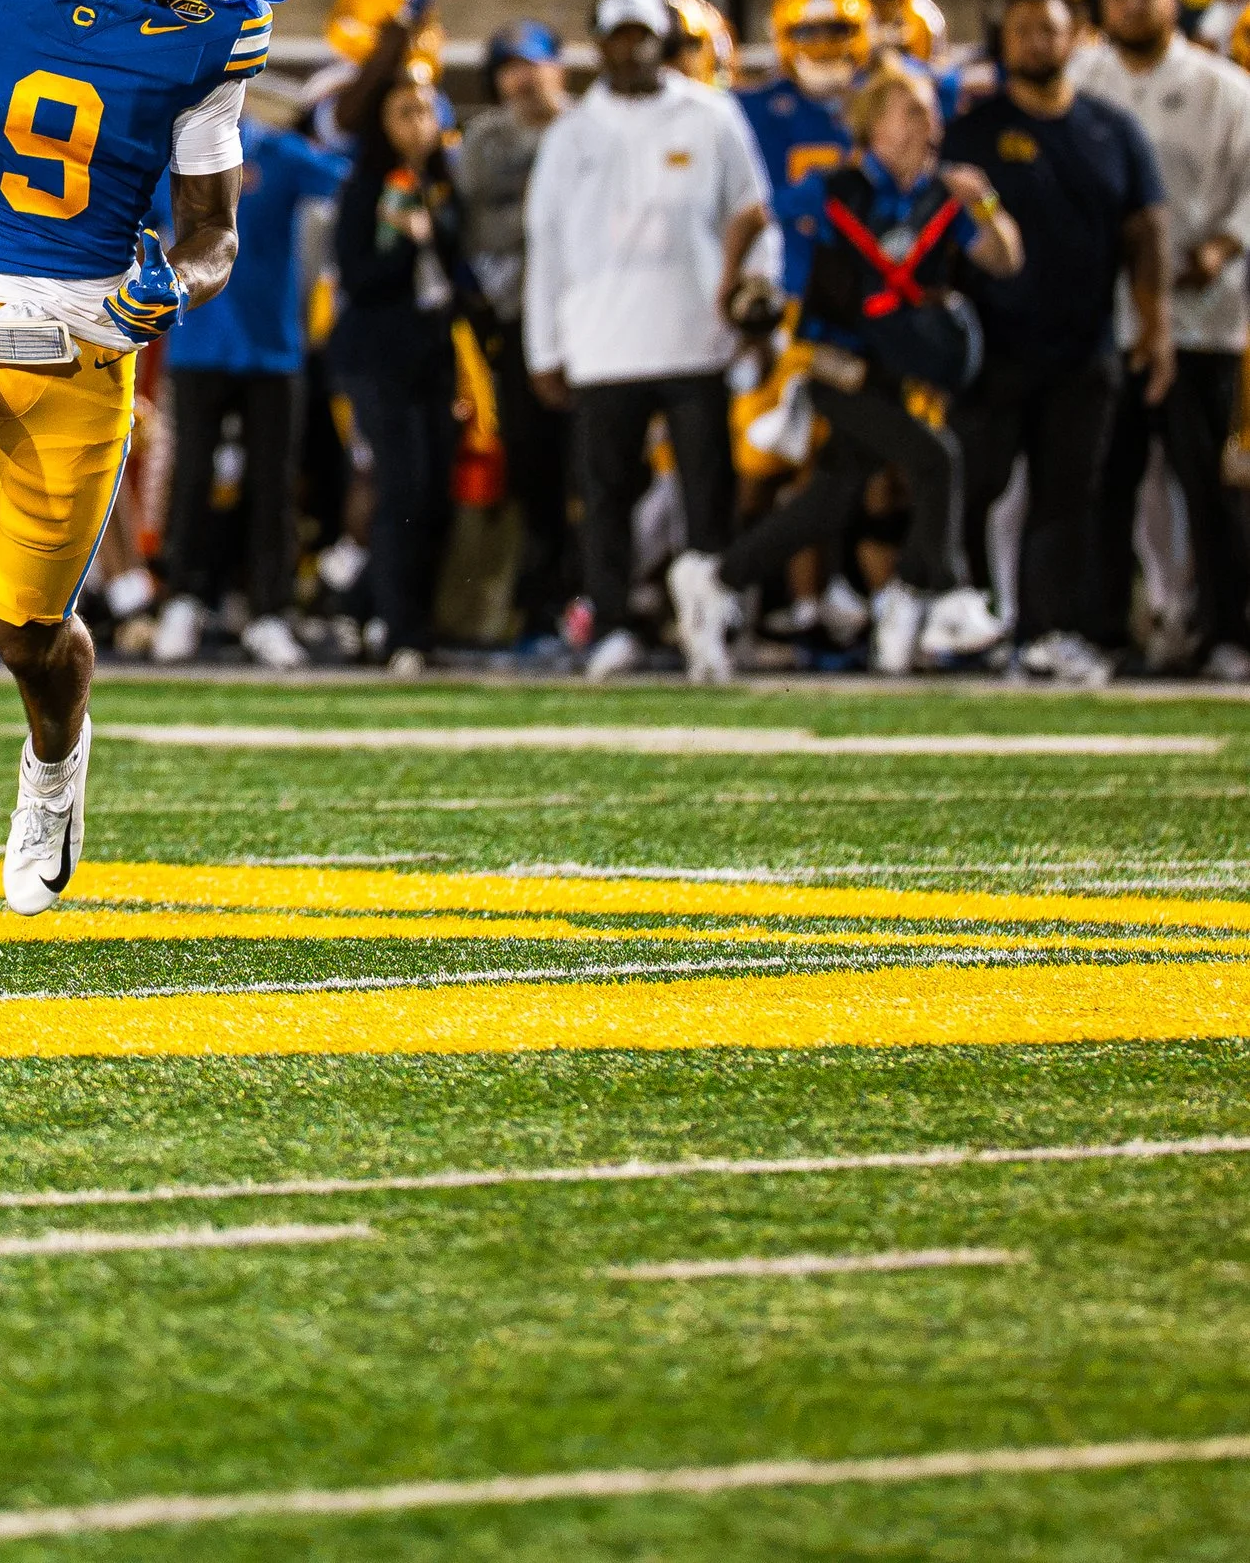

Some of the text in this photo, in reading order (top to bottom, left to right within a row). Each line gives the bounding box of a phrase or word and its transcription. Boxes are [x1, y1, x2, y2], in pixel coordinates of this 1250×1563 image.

[72, 5, 95, 26] C
[176, 2, 208, 16] ACC
[0, 69, 105, 220] 9
